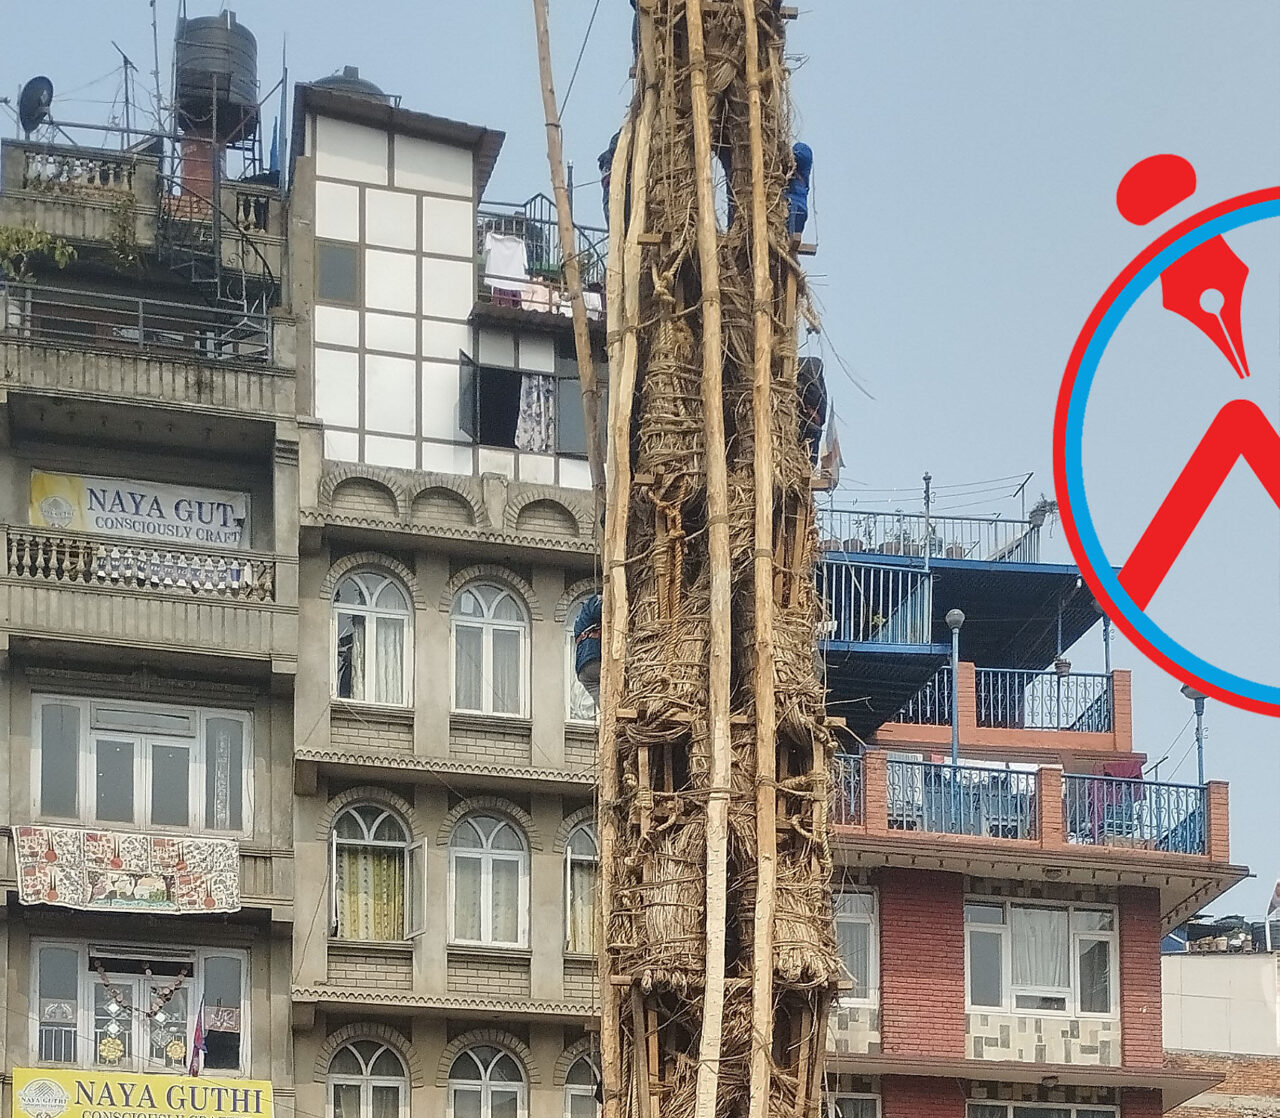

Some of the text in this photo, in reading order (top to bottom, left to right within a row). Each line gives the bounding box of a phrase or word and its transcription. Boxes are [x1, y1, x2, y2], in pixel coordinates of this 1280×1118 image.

[86, 487, 237, 528] NAYA GUT
[95, 516, 193, 539] CONSCIOUSLY
[75, 1081, 264, 1114] NAYA GUTHI
